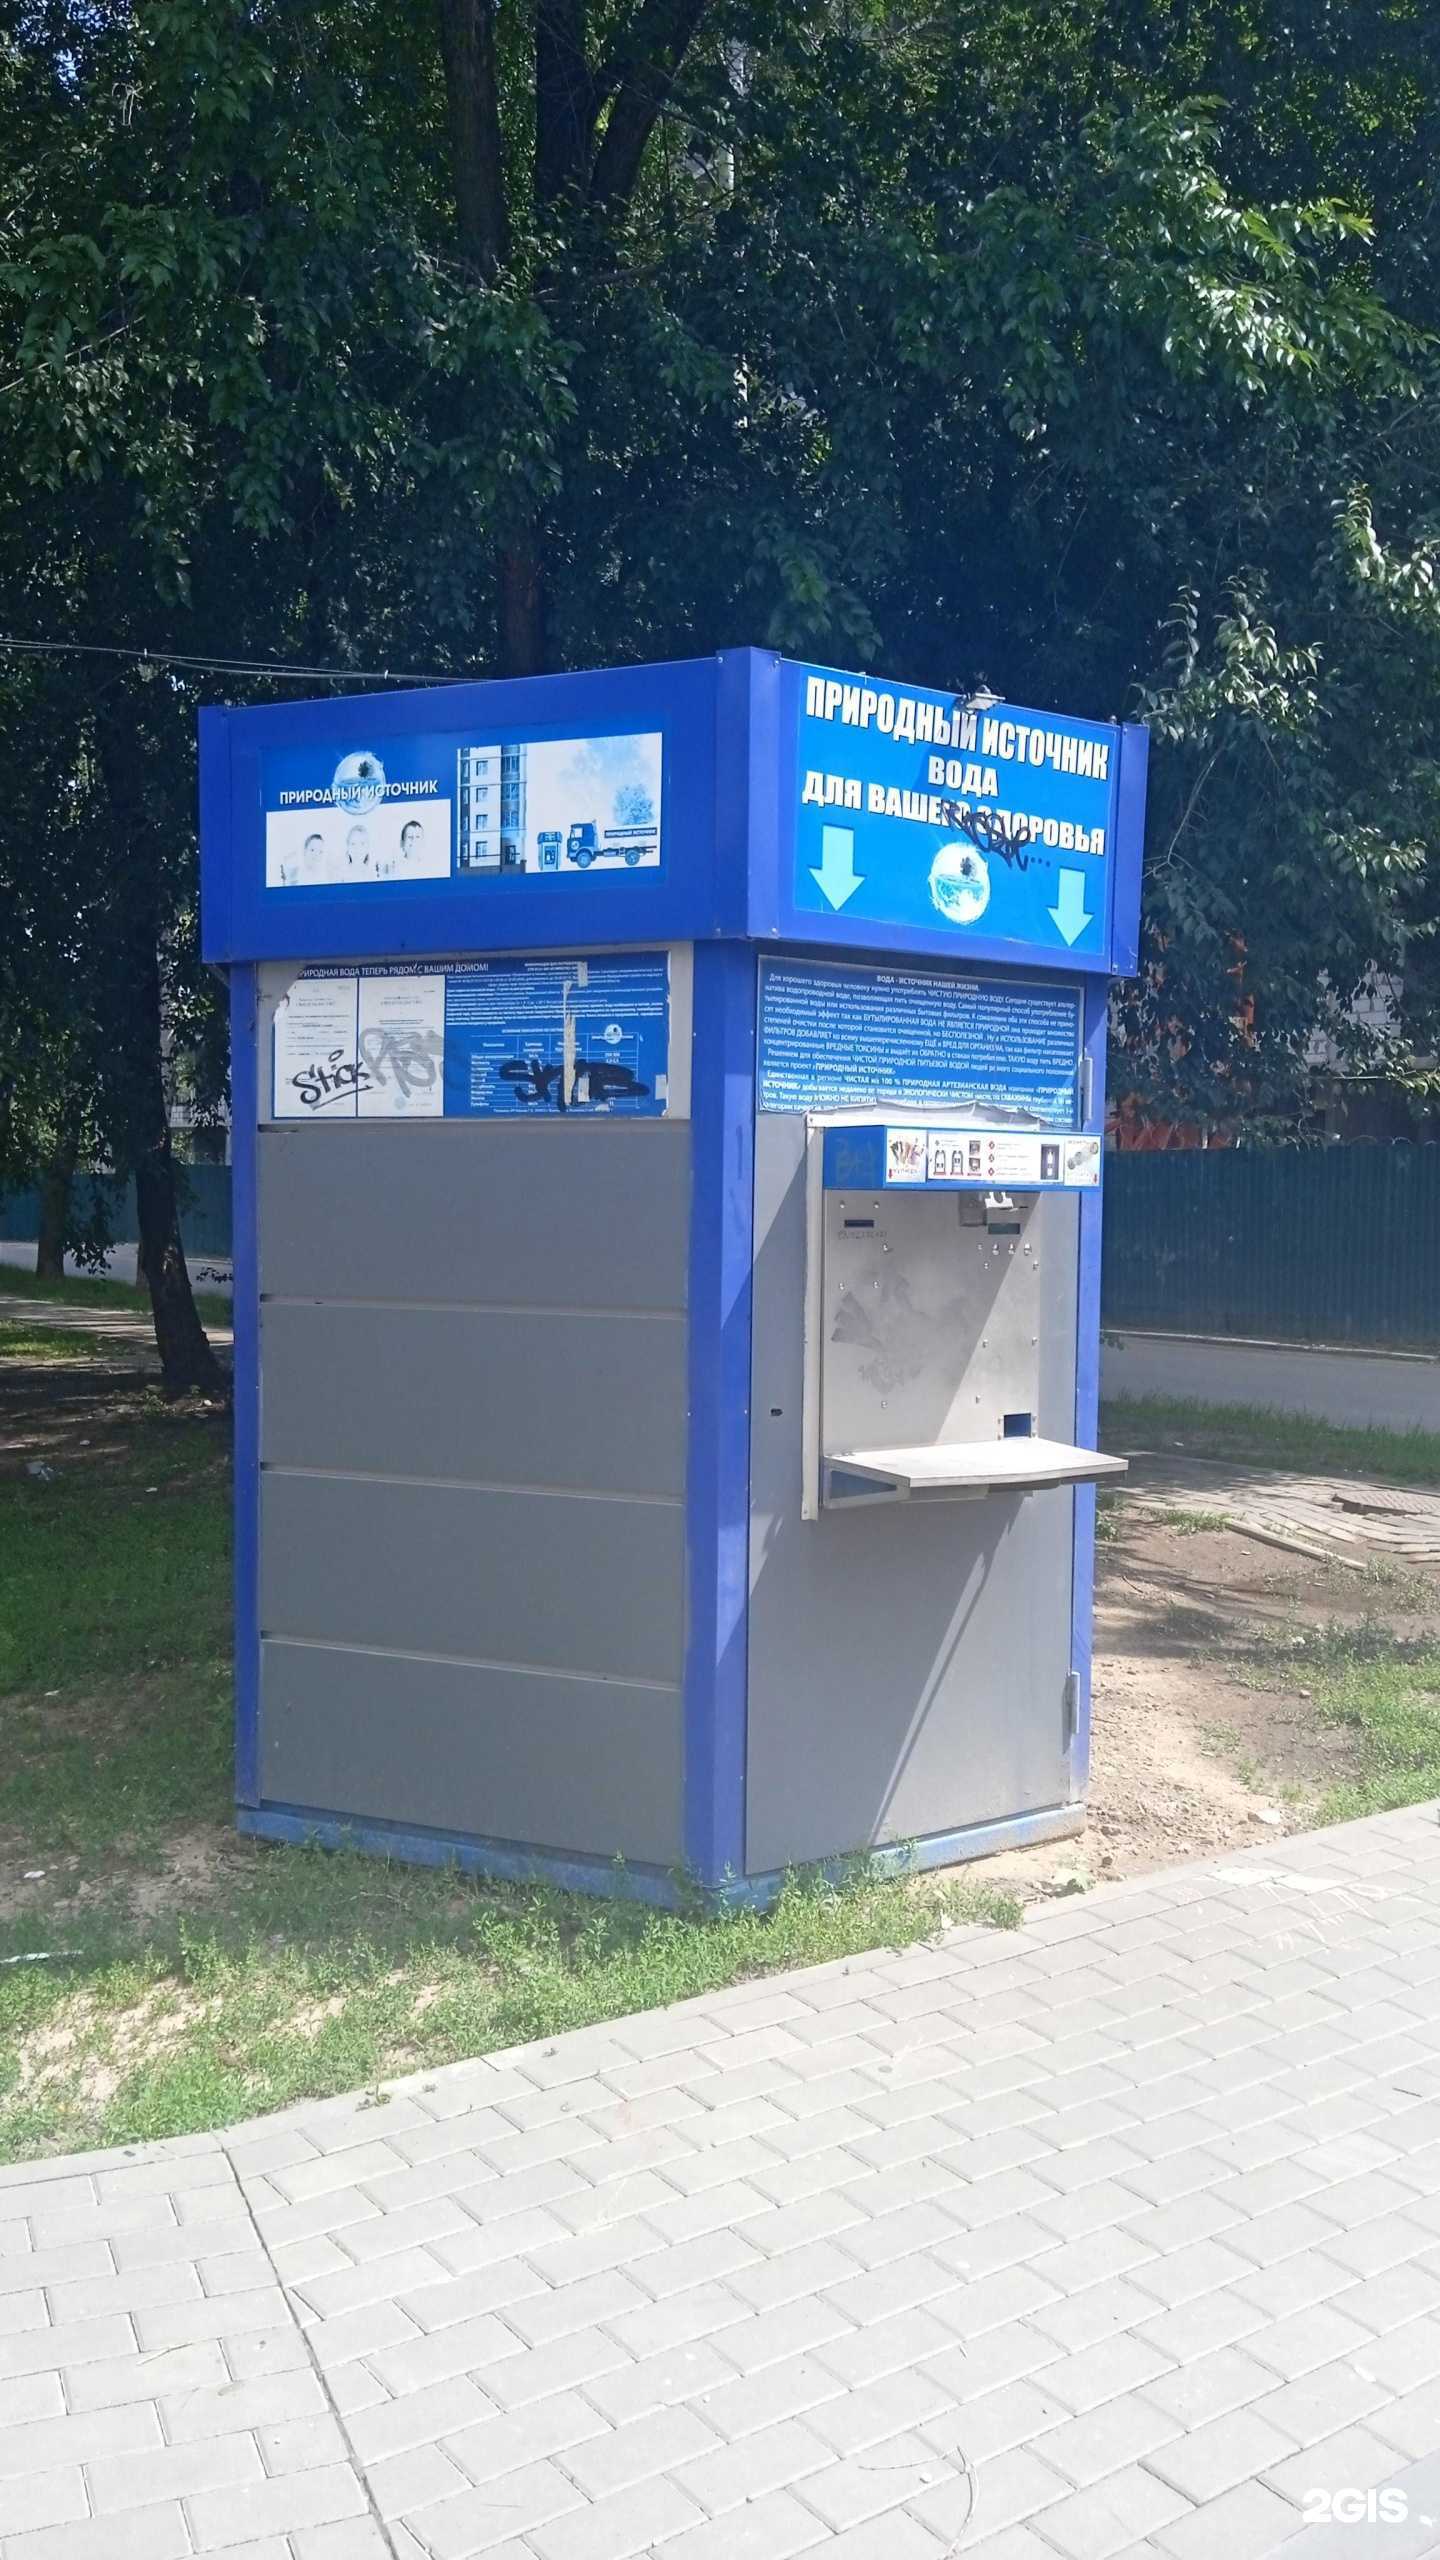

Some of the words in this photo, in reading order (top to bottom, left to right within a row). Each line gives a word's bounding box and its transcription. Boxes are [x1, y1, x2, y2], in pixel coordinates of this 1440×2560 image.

[806, 676, 978, 752] ПРИРОДНЫЙ
[982, 717, 1109, 780] ИСТОЧНИК
[279, 785, 362, 805] ПРИРОДНЫЙ
[365, 779, 439, 799] ИСТОЧНИК
[928, 755, 999, 798] ВОДА
[802, 770, 862, 808] ДЛЯ
[975, 805, 1106, 856] ЗДОРОВЬЯ
[340, 967, 360, 976] ВОДА
[362, 966, 388, 976] ТЕПЕРЬ
[424, 963, 454, 974] ВАШИМ
[455, 962, 489, 974] ДОМОМ!
